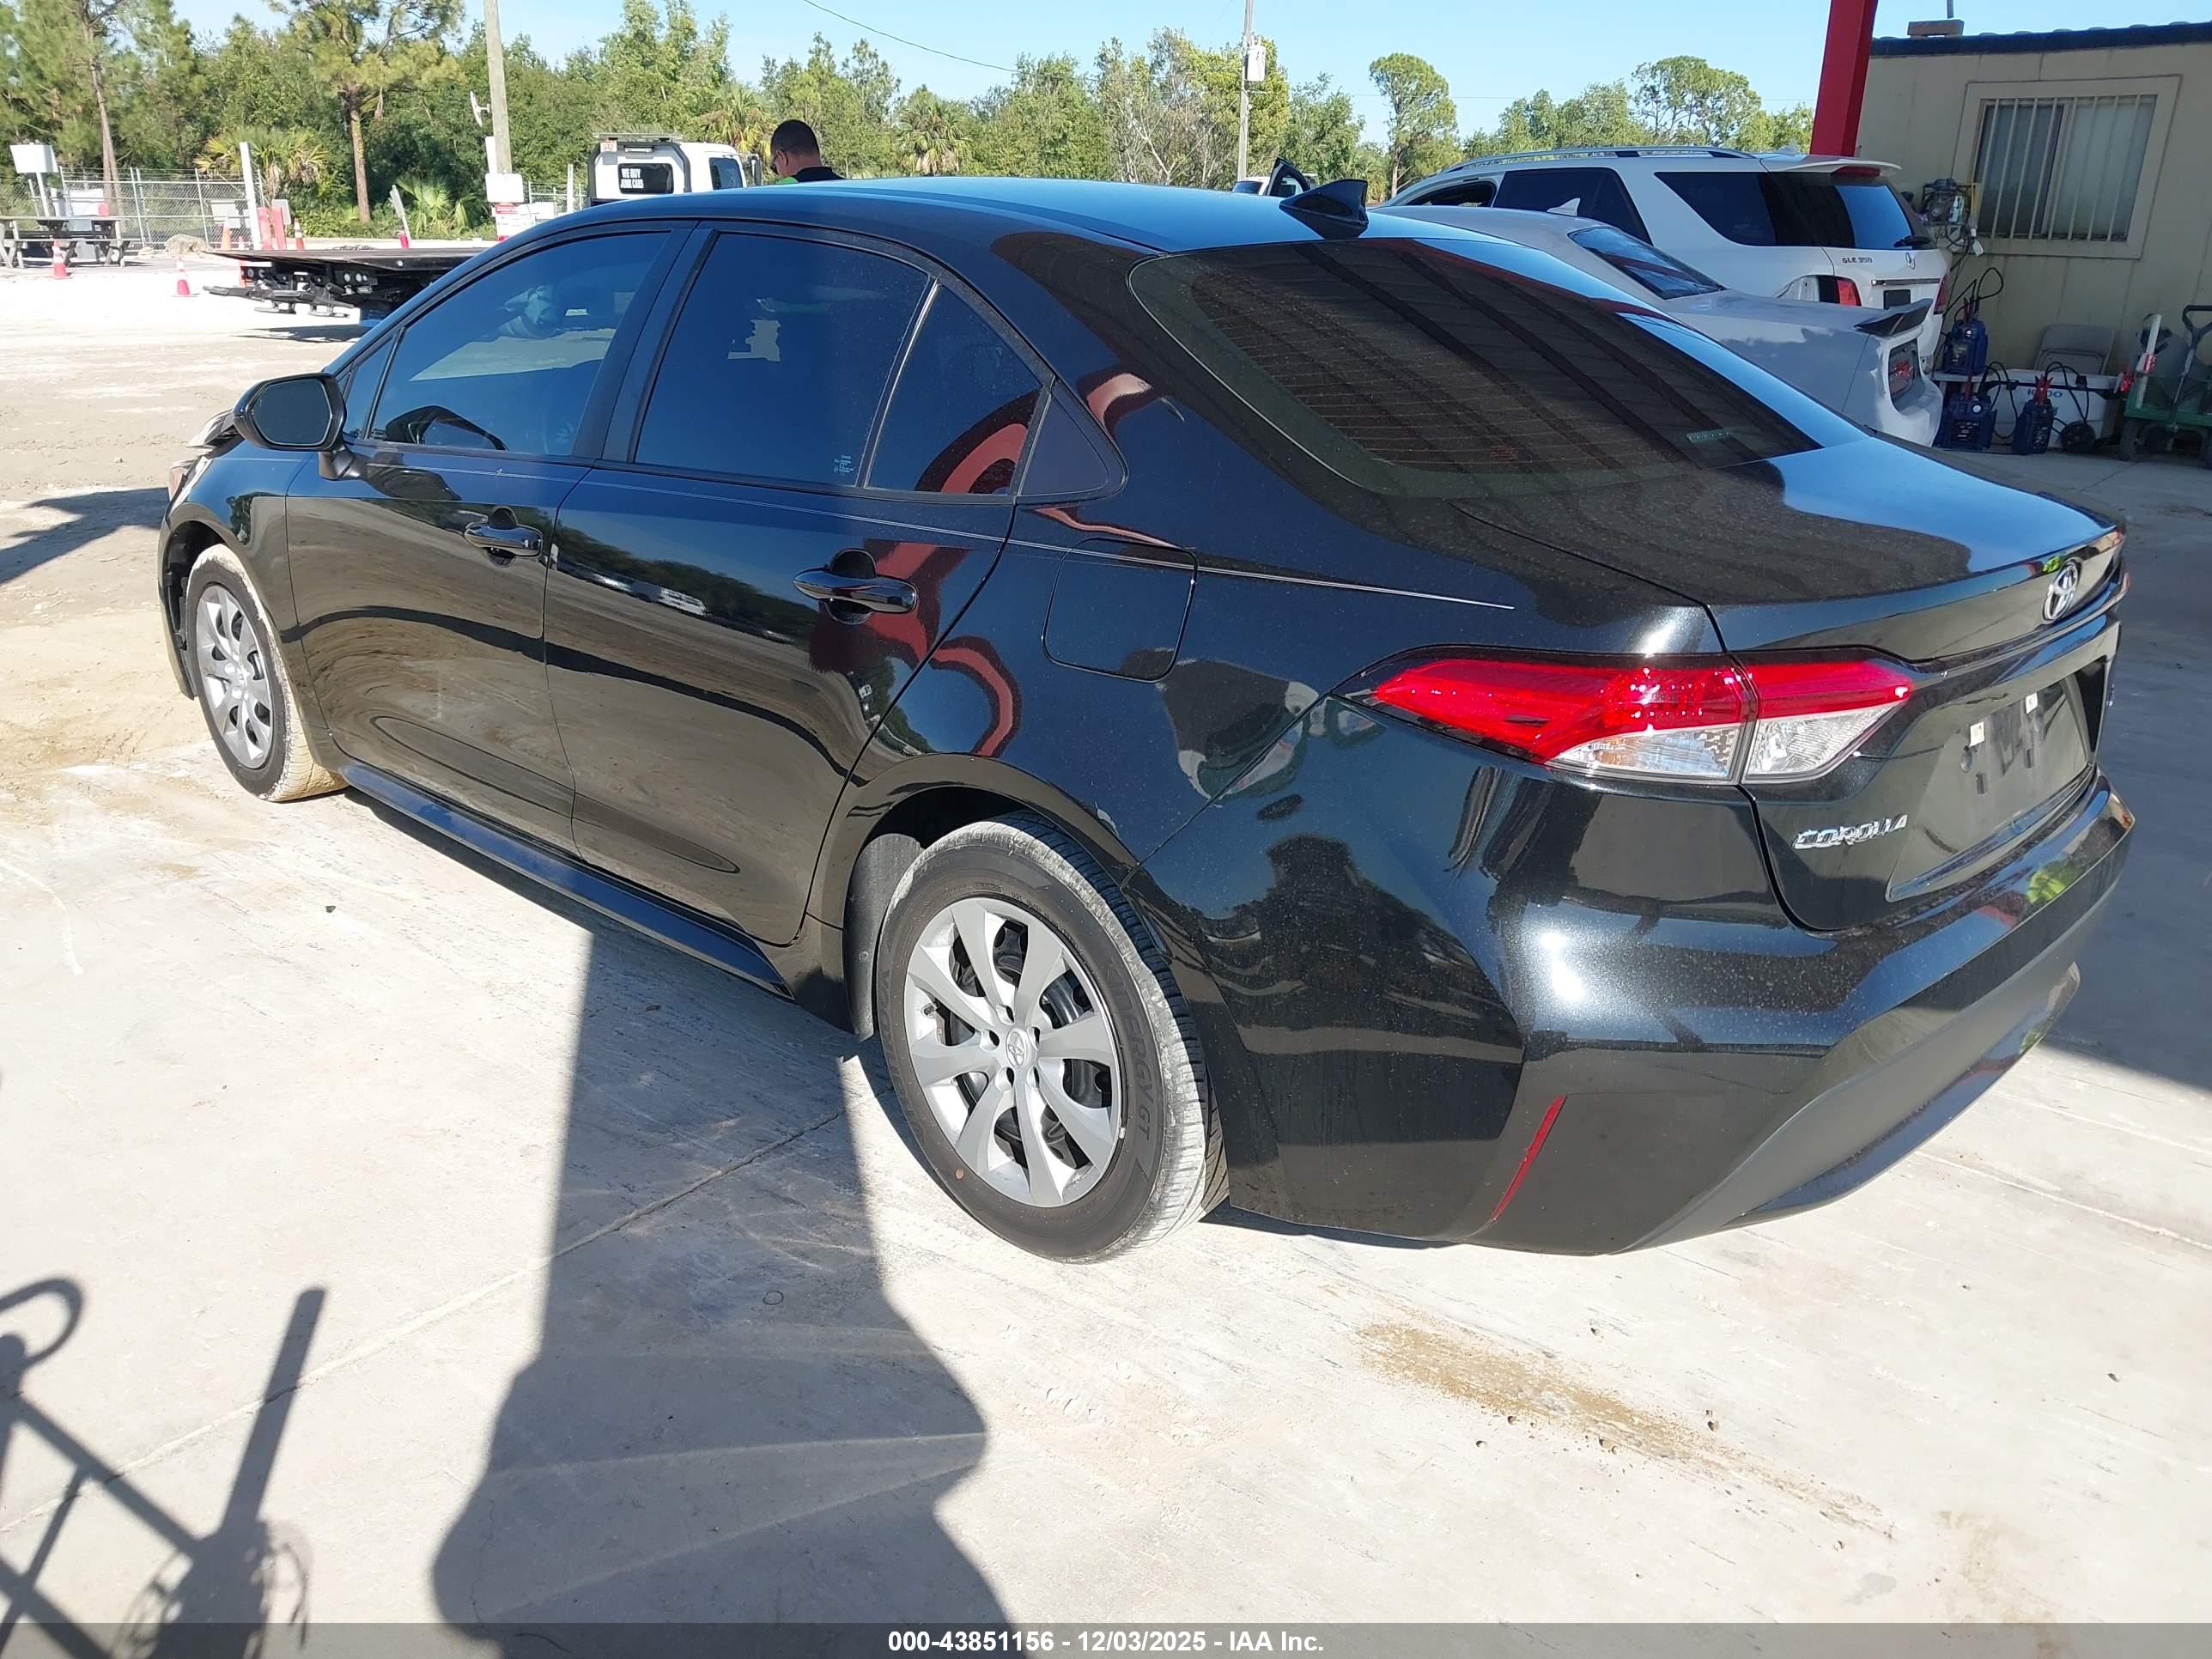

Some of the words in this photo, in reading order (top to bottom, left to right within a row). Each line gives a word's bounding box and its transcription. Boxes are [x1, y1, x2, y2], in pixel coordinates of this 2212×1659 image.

[621, 167, 630, 179] WE
[630, 167, 641, 179] BUY
[1793, 814, 1908, 849] COROLLA
[1102, 957, 1154, 1104] KINERGY
[1137, 1104, 1152, 1140] GT
